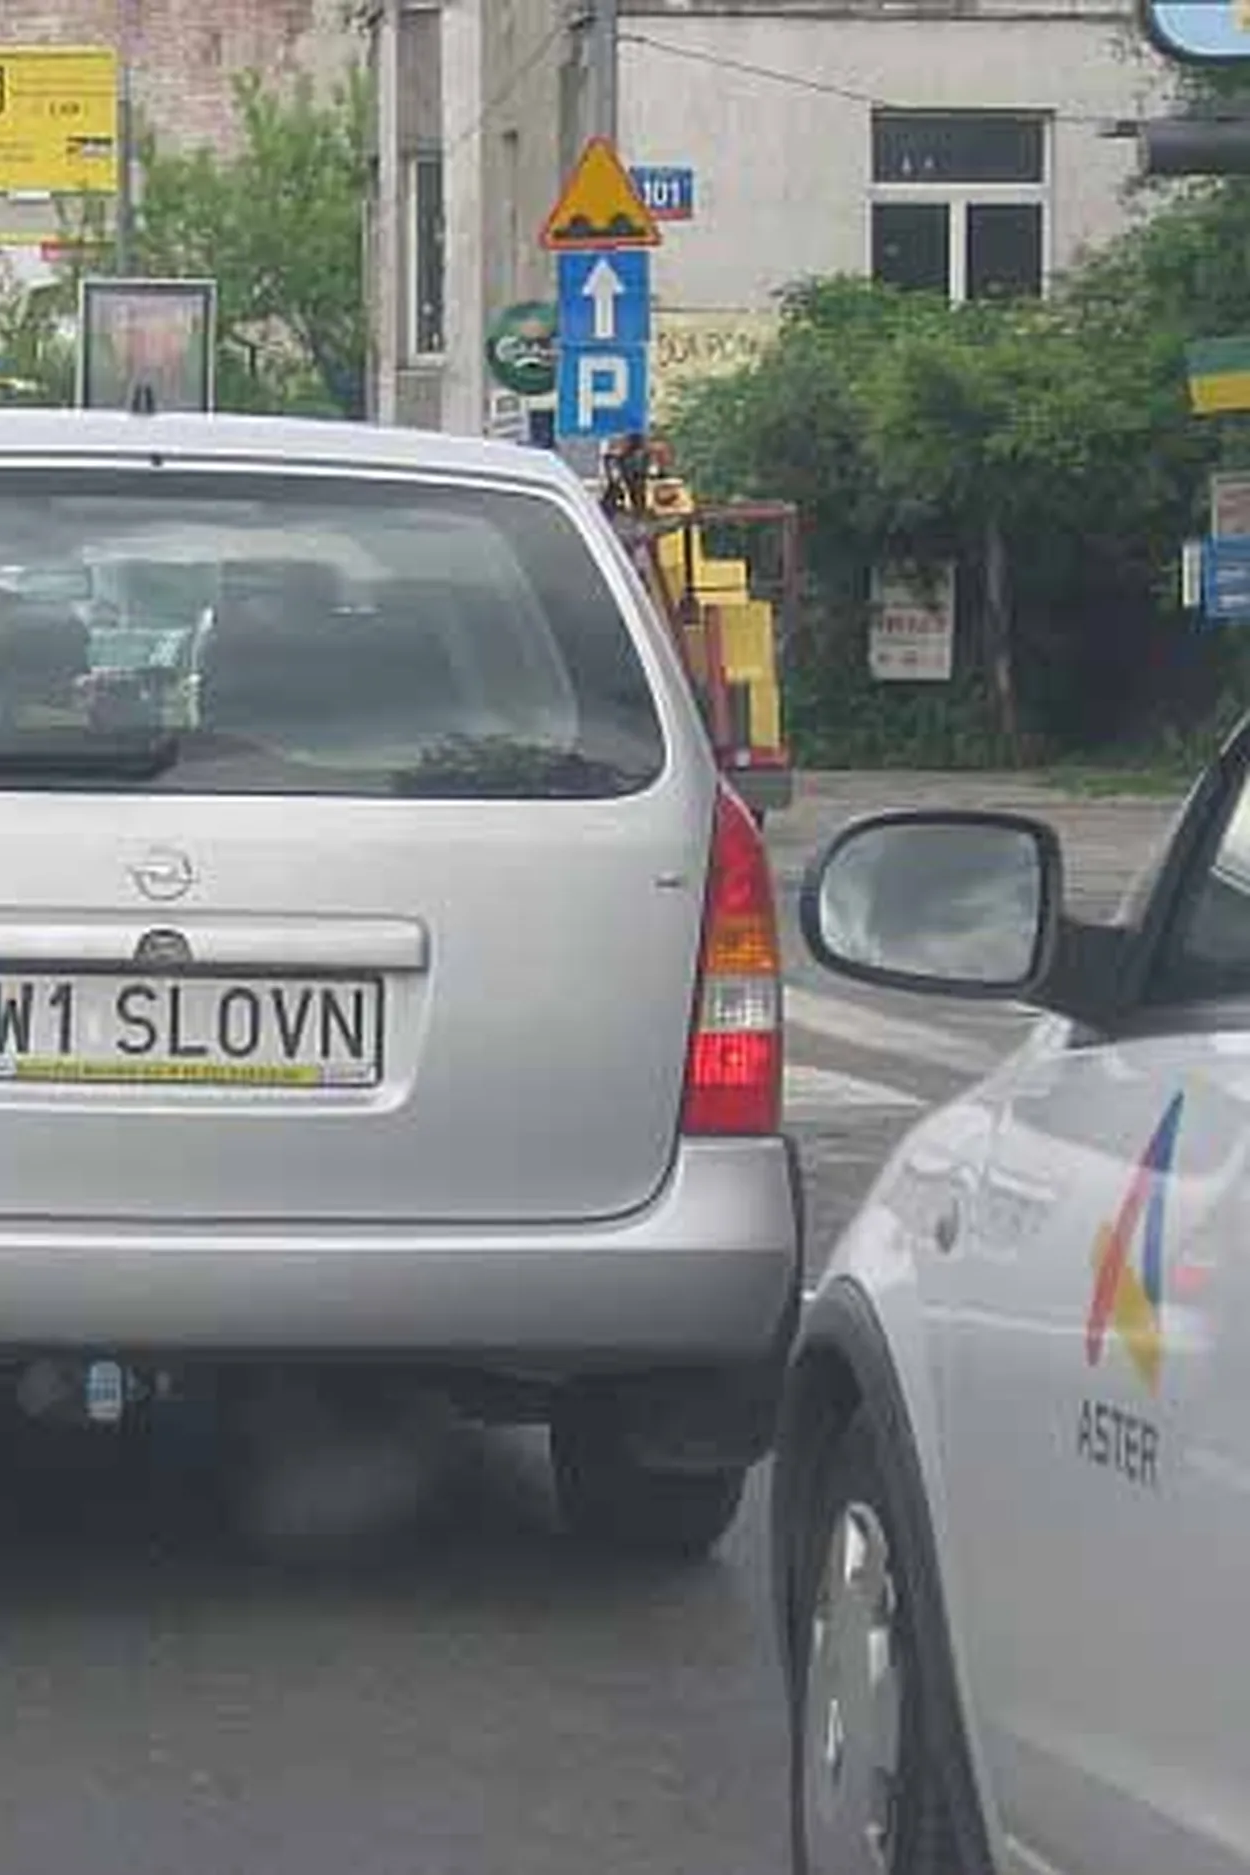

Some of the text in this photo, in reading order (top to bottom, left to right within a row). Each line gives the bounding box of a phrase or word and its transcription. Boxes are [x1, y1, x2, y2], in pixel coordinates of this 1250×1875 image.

[643, 181, 681, 207] 101
[578, 355, 630, 429] P
[115, 984, 365, 1060] SLOVN
[1076, 1398, 1161, 1489] ASTER
